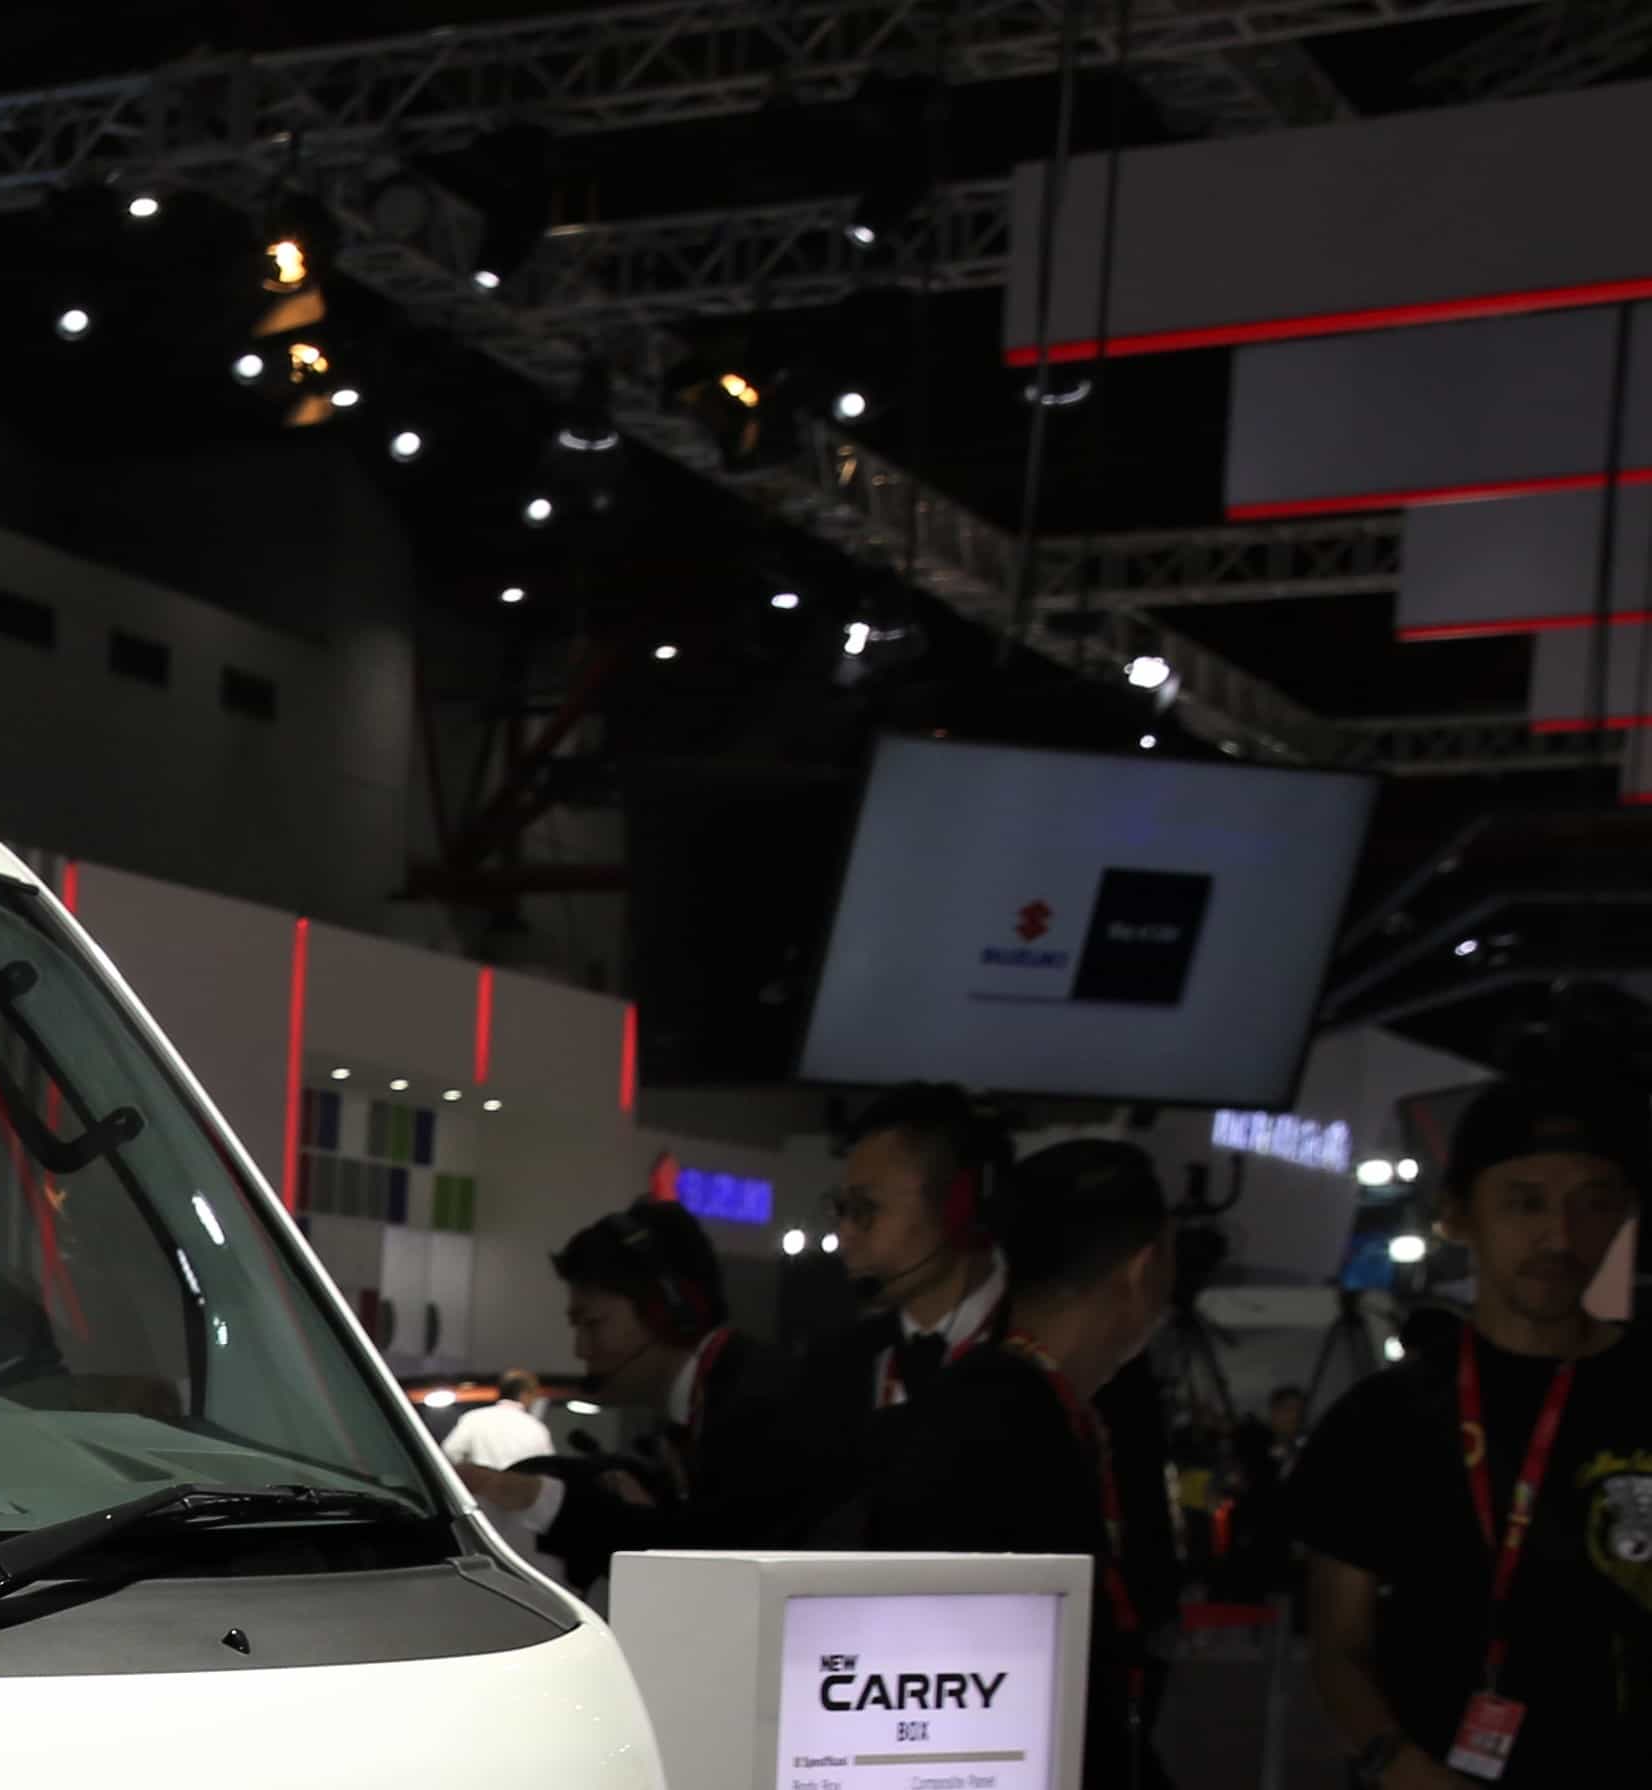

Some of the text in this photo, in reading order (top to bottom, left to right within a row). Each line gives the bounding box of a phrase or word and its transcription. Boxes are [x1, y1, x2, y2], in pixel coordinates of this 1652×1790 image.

[819, 1654, 858, 1672] NEW
[820, 1672, 1007, 1711] CARRY
[895, 1721, 930, 1741] BOX
